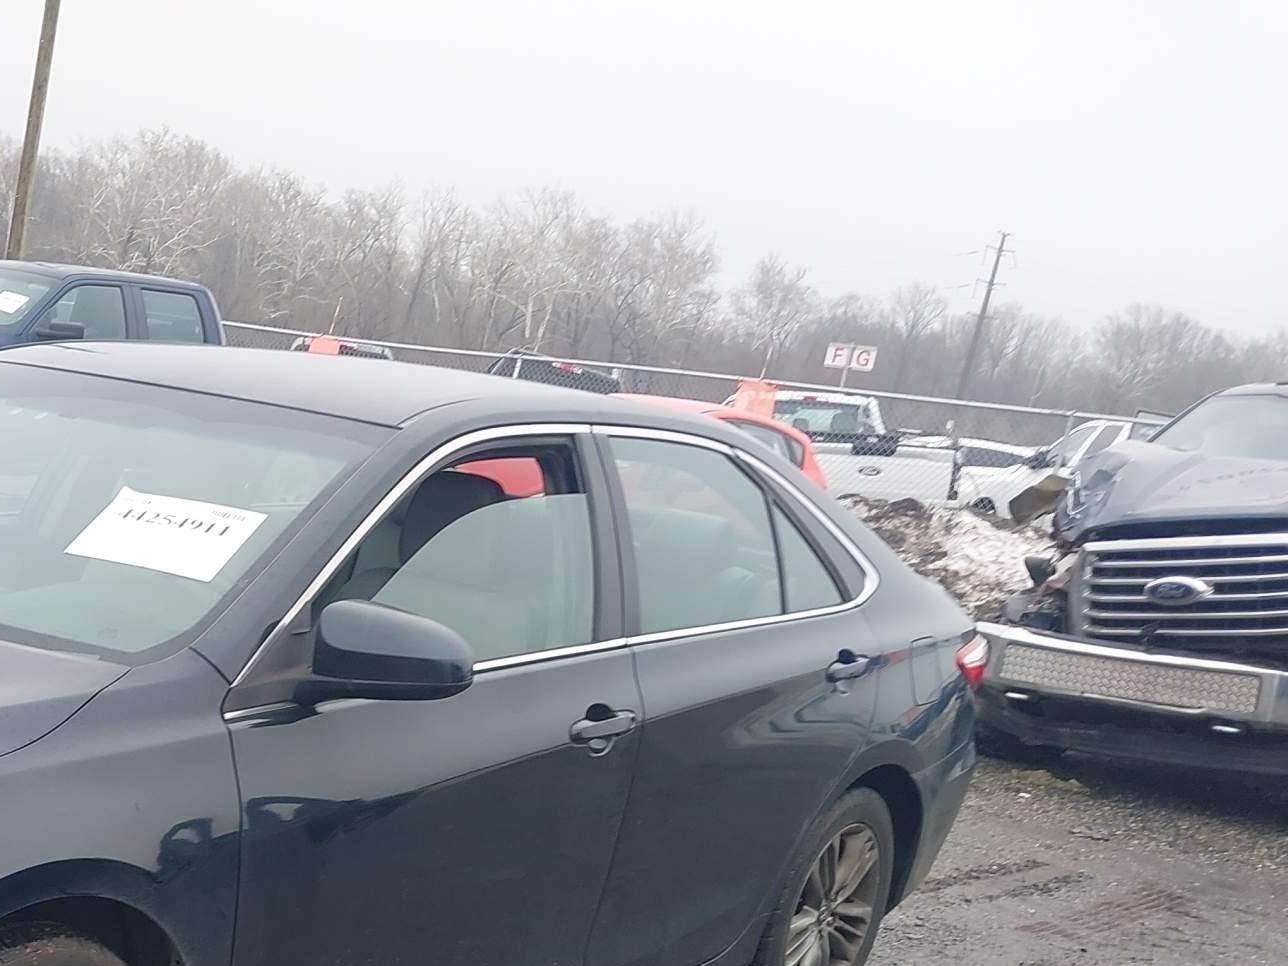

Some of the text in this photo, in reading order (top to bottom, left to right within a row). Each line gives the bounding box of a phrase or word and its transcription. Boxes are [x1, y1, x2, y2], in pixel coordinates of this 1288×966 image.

[832, 347, 844, 363] F
[856, 350, 871, 367] G
[117, 508, 231, 536] 44254911
